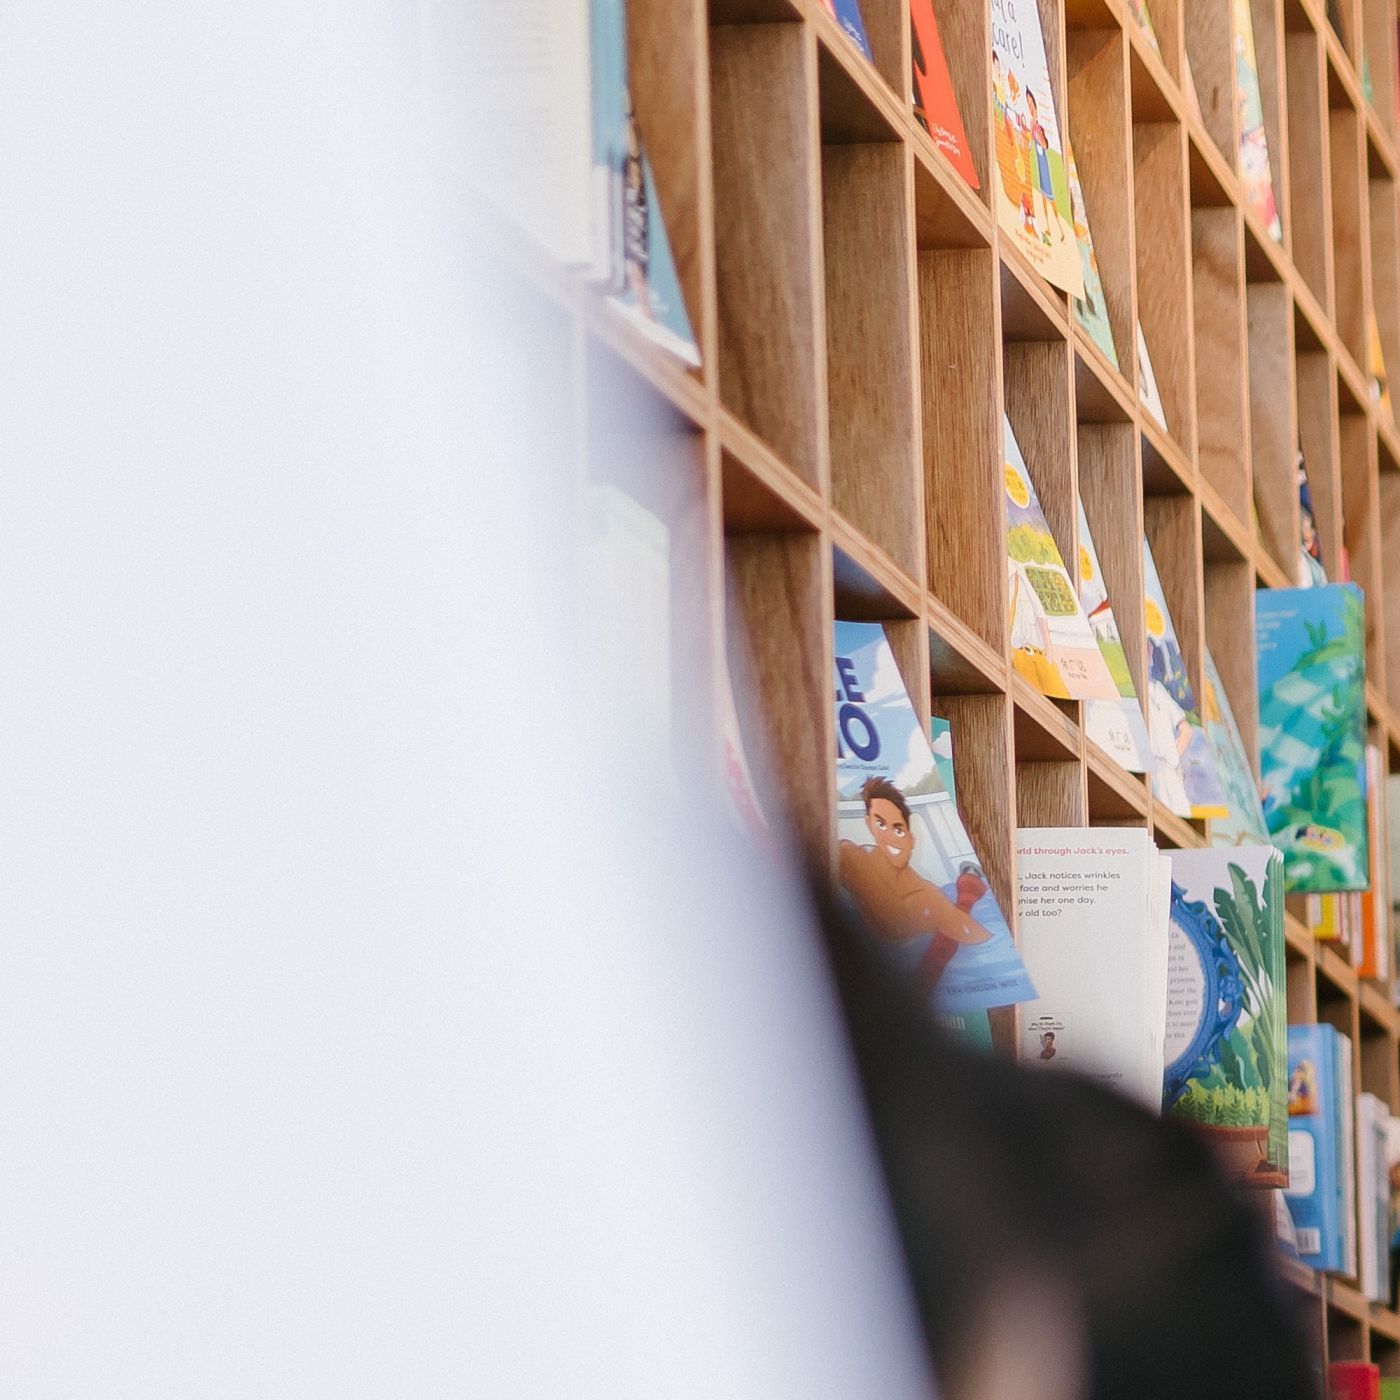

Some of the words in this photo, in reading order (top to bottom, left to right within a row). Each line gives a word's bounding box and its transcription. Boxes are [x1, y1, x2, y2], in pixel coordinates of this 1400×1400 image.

[1034, 847, 1071, 856] through
[1073, 847, 1103, 855] Jack's
[1105, 847, 1130, 857] eyes.
[1024, 871, 1047, 880] Jack
[1049, 871, 1082, 880] notices
[1084, 871, 1121, 879] wrinkles
[1019, 884, 1039, 892] face
[1041, 884, 1060, 892] and
[1062, 884, 1094, 892] worries
[1096, 884, 1108, 892] he
[1040, 896, 1055, 904] her
[1025, 909, 1040, 917] old
[1042, 908, 1062, 917] too?
